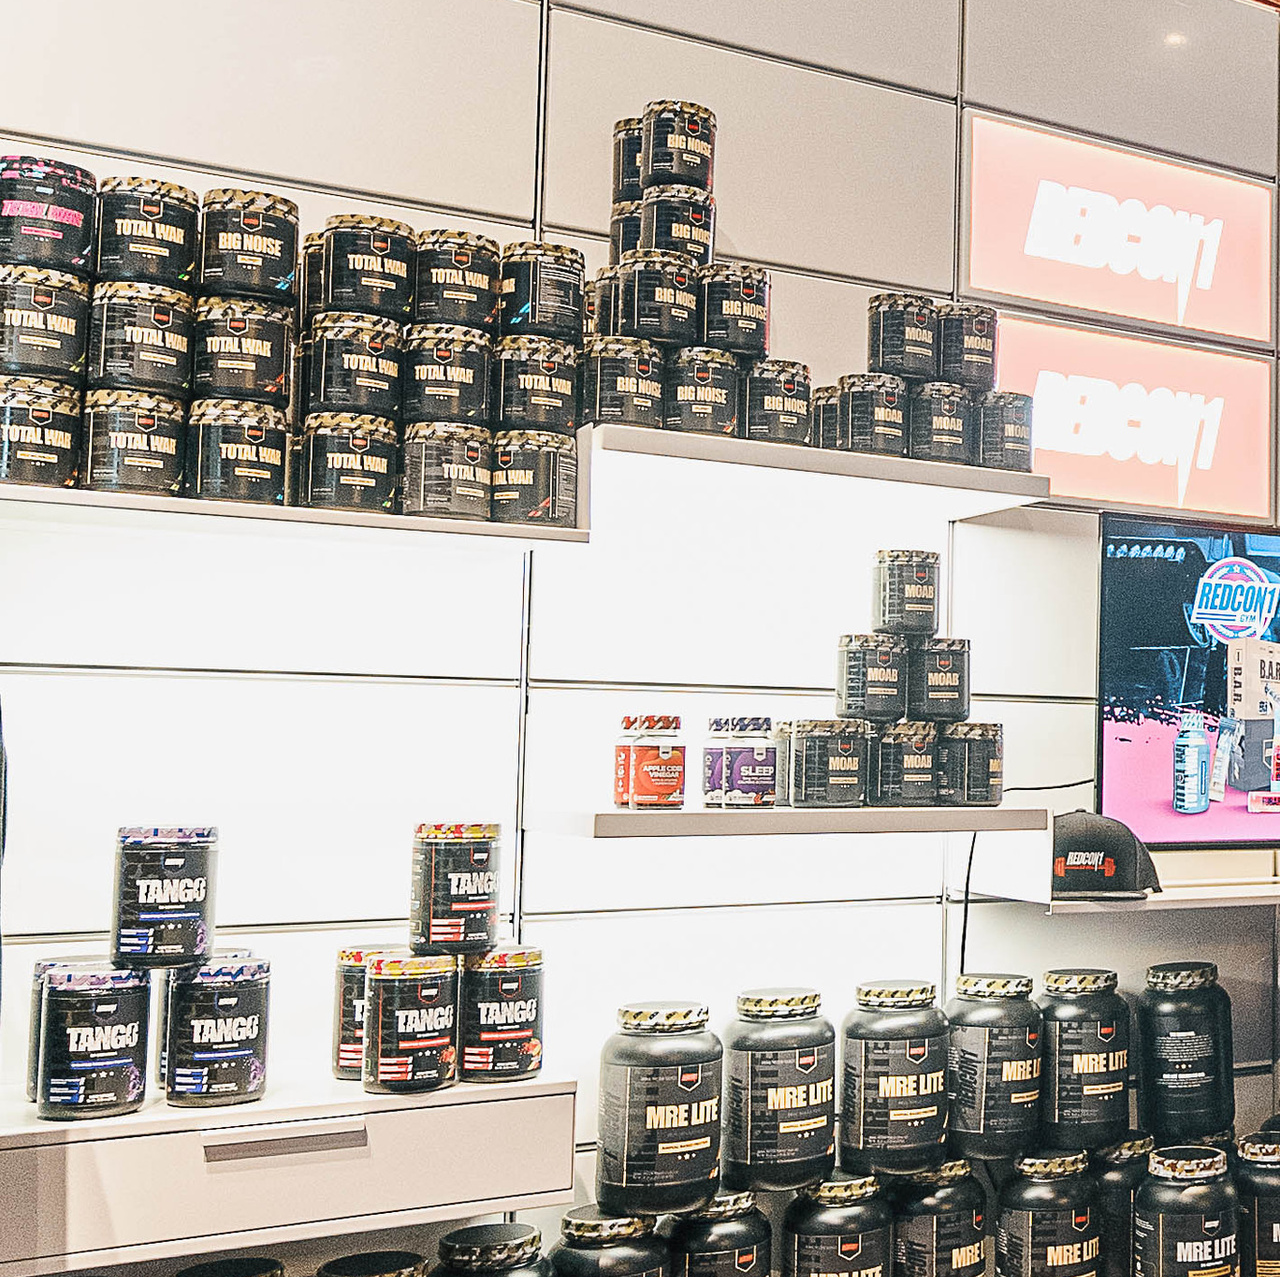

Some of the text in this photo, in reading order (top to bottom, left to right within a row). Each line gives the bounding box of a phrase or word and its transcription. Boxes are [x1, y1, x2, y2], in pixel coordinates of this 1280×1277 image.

[667, 133, 687, 149] BIG
[115, 218, 185, 245] TOTAL WAR
[672, 223, 711, 244] BIG NOIS
[218, 231, 283, 257] BIG NOISE
[347, 254, 408, 279] TOTAL WAR
[430, 268, 490, 290] TOTAL WAR
[654, 286, 674, 303] BIG
[722, 299, 768, 321] BIG NOISE
[3, 308, 76, 336] TOTAL WAR
[124, 325, 188, 353] TOTAL WAR
[905, 326, 934, 344] MOAB
[963, 335, 994, 352] MOAB
[206, 336, 272, 358] TOTAL WAR
[342, 353, 379, 372] TOTAL
[414, 364, 474, 384] TOTAL WAR
[518, 374, 552, 391] TOTAL
[616, 376, 638, 394] BIG
[676, 385, 729, 404] BIG NOISE
[763, 395, 808, 415] BIG NOISE
[874, 407, 904, 424] MOAB
[932, 416, 964, 431] MOAB
[1, 423, 72, 450] TOTAL WAR
[109, 431, 177, 455] TOTAL WAR
[219, 443, 282, 466] TOTAL WAR
[327, 452, 389, 474] TOTAL WAR
[443, 463, 491, 485] TOTAL WA
[508, 470, 534, 485] WAR
[905, 584, 934, 599] MOAB
[1197, 582, 1277, 617] REDCON1
[867, 667, 898, 683] MOAB
[928, 672, 960, 687] MOAB
[740, 765, 775, 776] SLEEP
[828, 755, 860, 771] MOAB
[903, 755, 933, 769] MOAB
[1066, 852, 1105, 871] REDCON1
[136, 877, 207, 904] TANGO
[395, 1005, 454, 1033] TANGO
[478, 1000, 537, 1025] TANGO
[66, 1023, 140, 1053] TANGO
[190, 1015, 260, 1045] TANGO
[1002, 1060, 1030, 1082] MRE
[1073, 1049, 1128, 1075] MRE LITE
[767, 1084, 808, 1110] MRE
[808, 1077, 833, 1102] LITE
[878, 1070, 945, 1099] MRE LITE
[645, 1101, 689, 1130] MRE
[690, 1095, 720, 1123] LITE
[952, 1241, 983, 1269] MRE
[1047, 1242, 1082, 1266] MRE
[1177, 1234, 1237, 1263] MRE LITE
